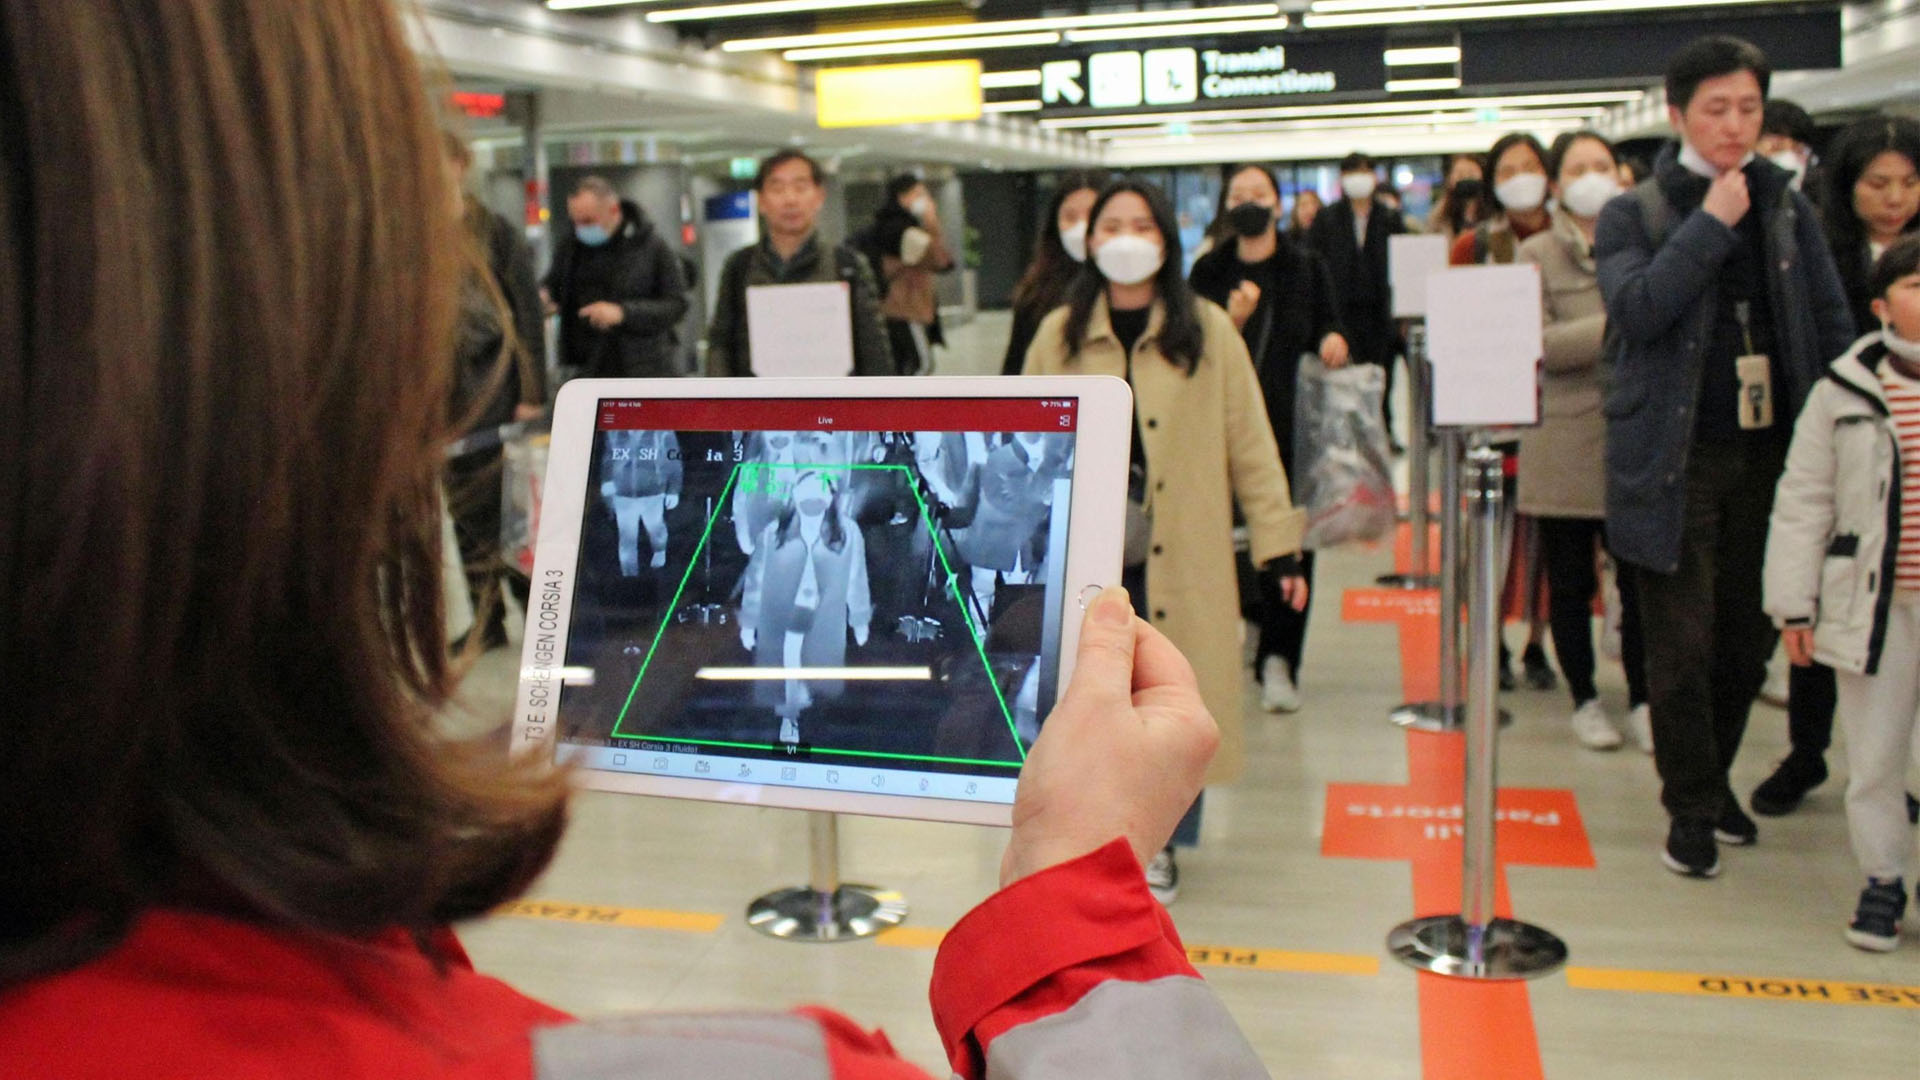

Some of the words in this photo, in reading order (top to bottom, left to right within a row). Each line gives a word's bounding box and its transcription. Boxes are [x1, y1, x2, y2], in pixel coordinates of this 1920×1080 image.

[1202, 68, 1336, 98] Connections
[818, 416, 833, 424] Live
[612, 448, 630, 460] EX
[639, 448, 658, 460] SH
[667, 448, 723, 461] Coia
[733, 449, 743, 461] 3
[545, 569, 564, 577] 3
[538, 581, 562, 630] CORSIA
[528, 633, 556, 708] SCHENGEN
[524, 726, 544, 741] T3
[1699, 978, 1830, 999] HOLD
